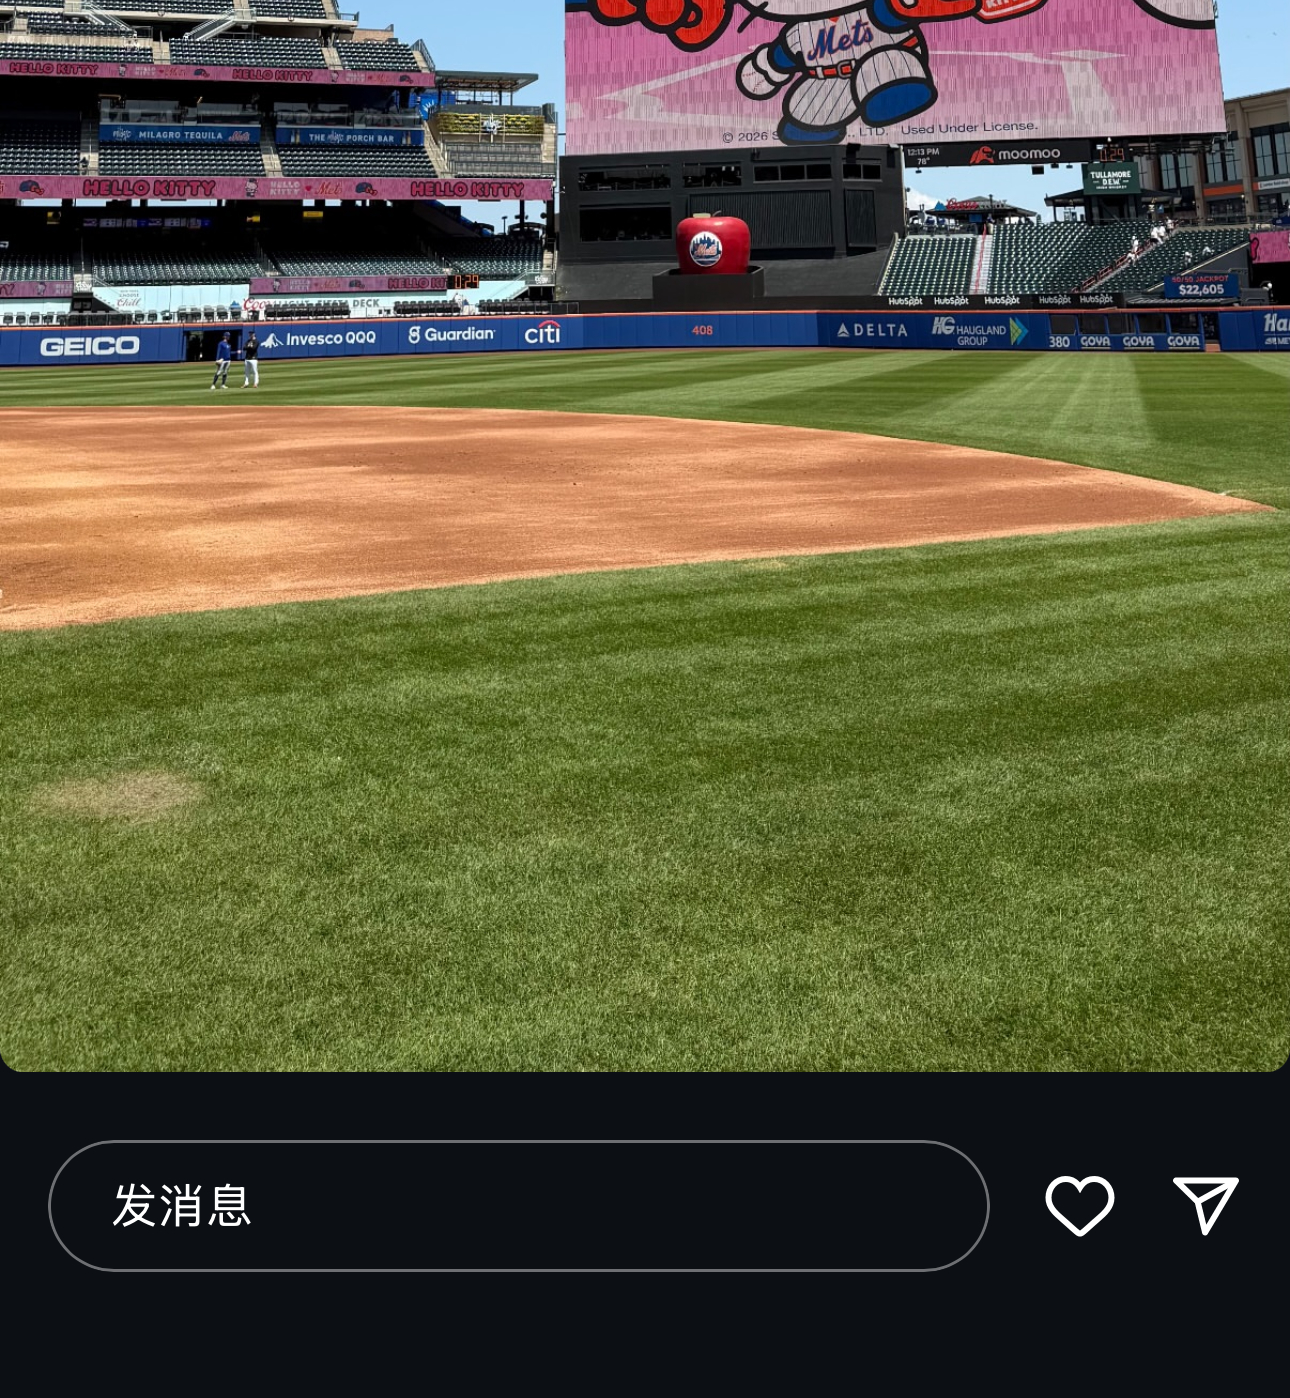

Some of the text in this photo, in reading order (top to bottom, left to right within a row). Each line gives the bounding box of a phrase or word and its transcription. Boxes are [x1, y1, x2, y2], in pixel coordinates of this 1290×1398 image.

[807, 19, 874, 61] Mets
[9, 62, 99, 75] HELLO KITTY
[232, 68, 313, 82] HELLO KITTY
[901, 121, 1039, 135] Used Under License.
[139, 130, 181, 139] MILAGRO
[184, 131, 223, 140] TEQUILA
[309, 133, 325, 142] THE
[346, 134, 374, 142] PORCH
[378, 134, 395, 143] BAR
[738, 131, 768, 142] 2026
[907, 147, 940, 156] 12:13 PM
[999, 148, 1061, 160] moomoo
[1090, 170, 1131, 179] TULLAMORE
[82, 179, 216, 196] HELLO KITTY
[410, 181, 525, 198] HELLO KITTY
[388, 277, 430, 289] HELLO
[454, 274, 479, 289] 0:29
[1196, 275, 1229, 283] JACKPOT
[1179, 284, 1225, 296] $22,605
[243, 297, 274, 311] Coo
[353, 298, 380, 308] DECK
[888, 296, 923, 307] HubSpot
[934, 295, 969, 307] HubSpot
[984, 294, 1020, 306] HubSpot
[1039, 294, 1071, 306] HubSpot
[1080, 294, 1113, 305] HubSpot
[931, 316, 955, 335] HG
[1264, 313, 1290, 332] Ha
[425, 326, 495, 342] Guardian
[524, 321, 560, 344] citi
[692, 325, 714, 336] 408
[853, 323, 908, 337] DELTA
[956, 325, 1006, 336] HAUGLAND
[286, 330, 376, 346] Invesco QQQ
[957, 336, 988, 346] GROUP
[1049, 336, 1070, 348] 380
[1080, 335, 1111, 347] GOYA
[1123, 335, 1155, 347] GOYA
[1167, 335, 1200, 347] GOYA
[40, 336, 140, 357] GEICO
